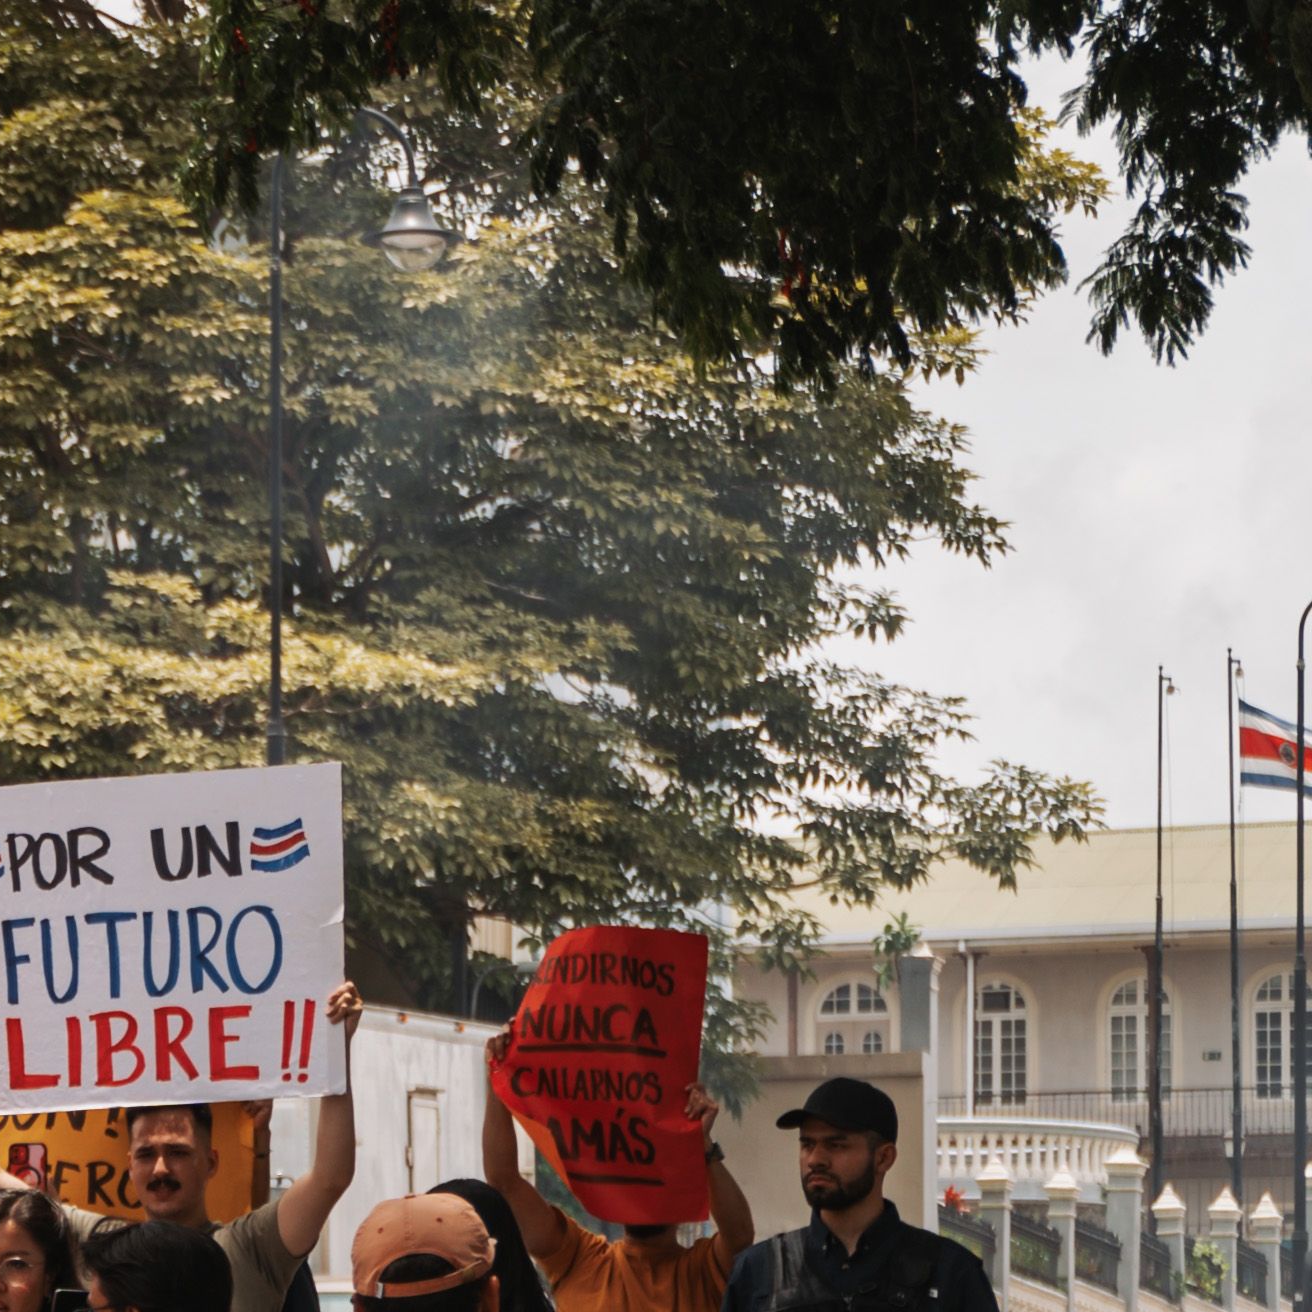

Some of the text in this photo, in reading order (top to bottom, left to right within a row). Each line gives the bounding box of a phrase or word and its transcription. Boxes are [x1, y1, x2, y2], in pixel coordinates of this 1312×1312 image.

[6, 820, 243, 892] POR UN
[1, 905, 283, 1005] FUTURO
[521, 1003, 660, 1046] NUNCA
